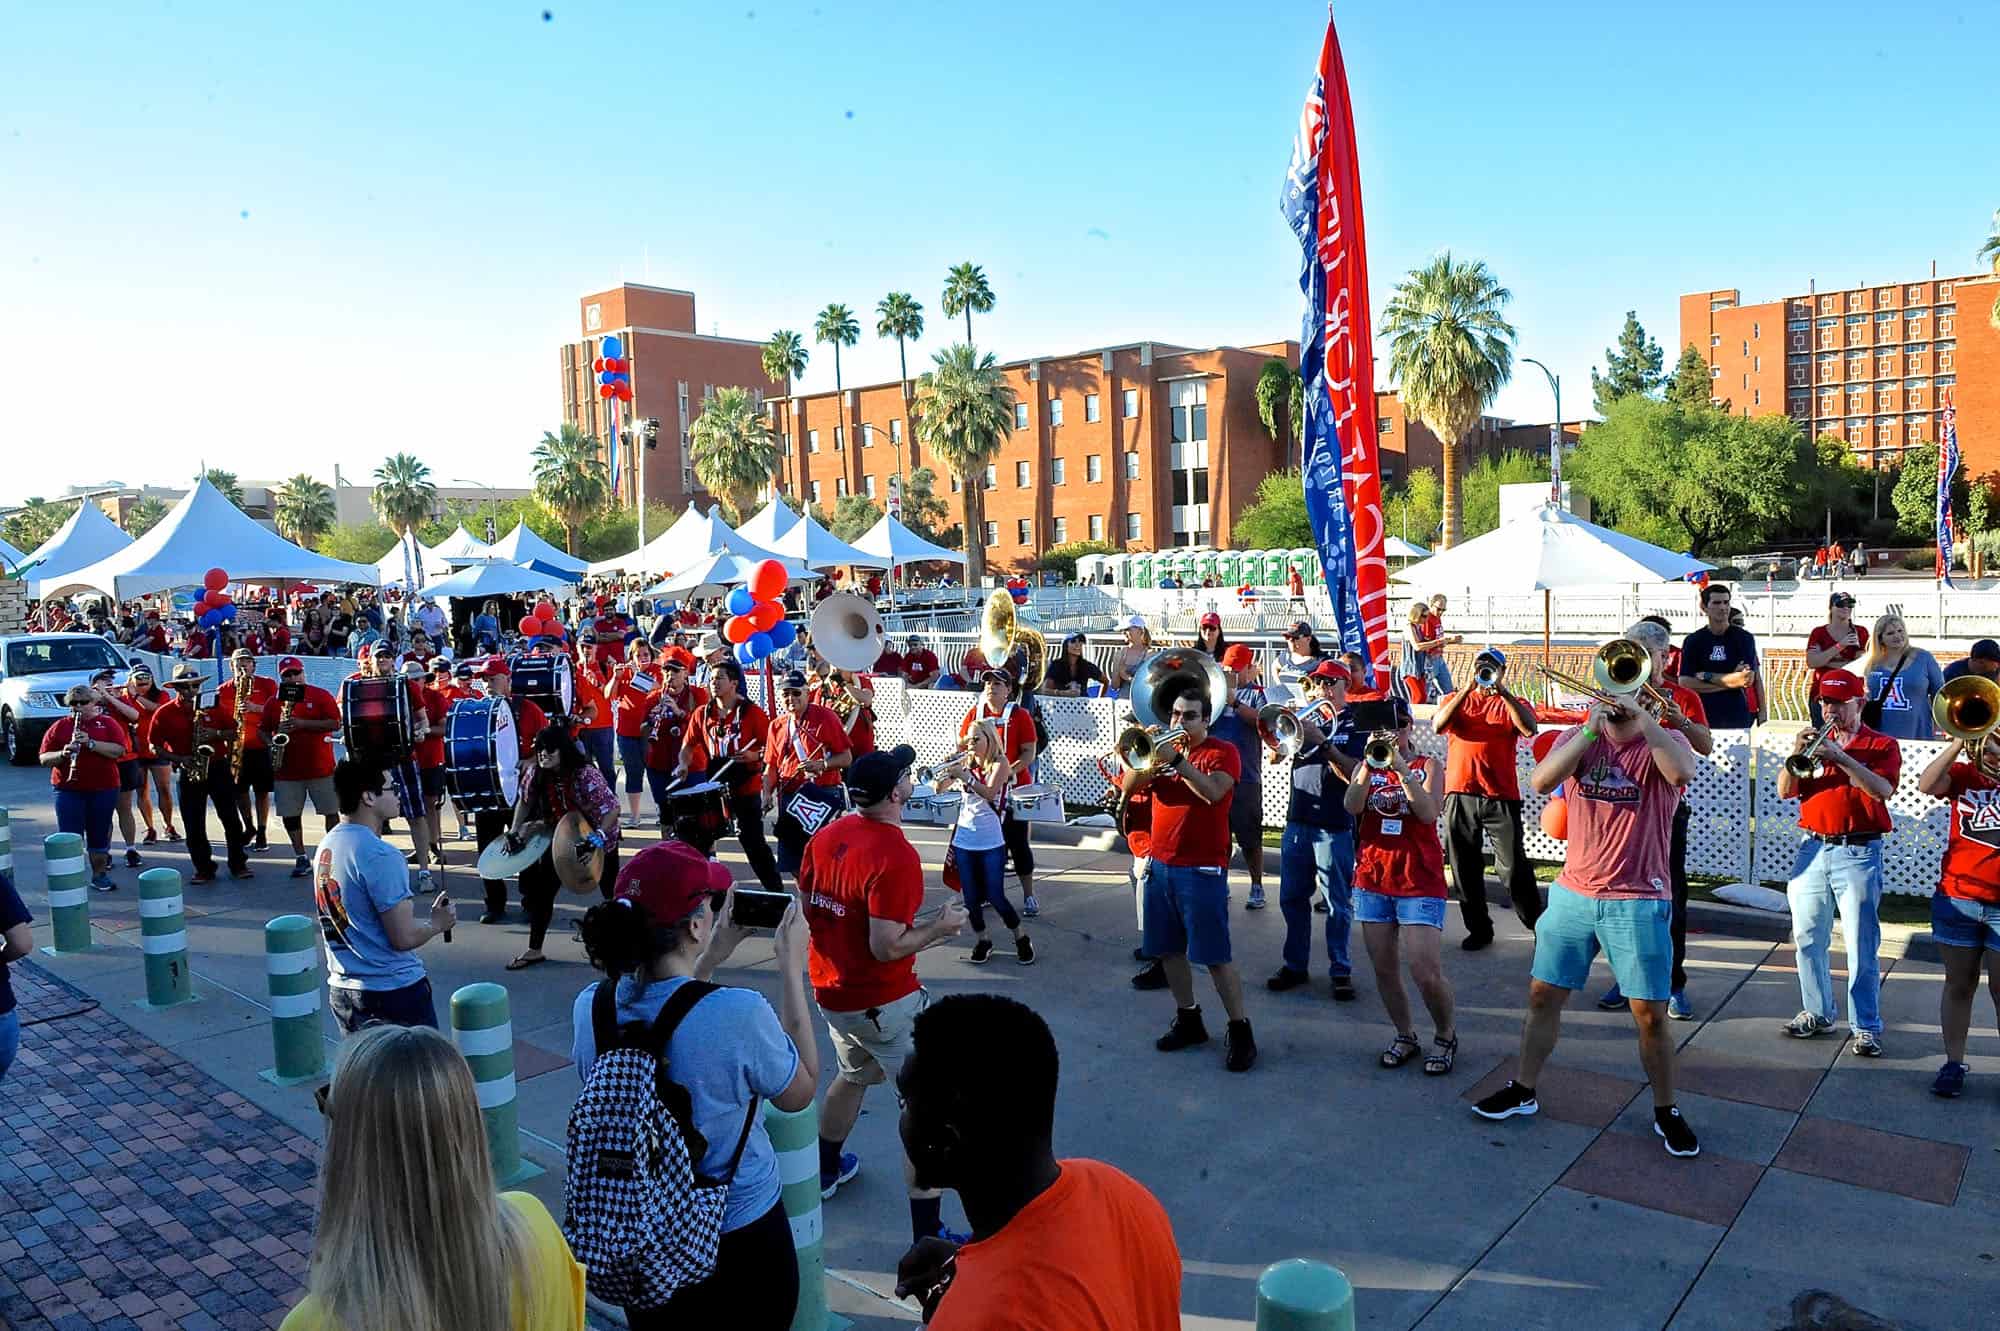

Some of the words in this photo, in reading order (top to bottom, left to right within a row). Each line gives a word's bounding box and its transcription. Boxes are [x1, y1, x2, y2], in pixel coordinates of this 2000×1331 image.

[1873, 677, 1911, 711] A
[1577, 783, 1638, 799] ARIZONA
[786, 793, 832, 836] A
